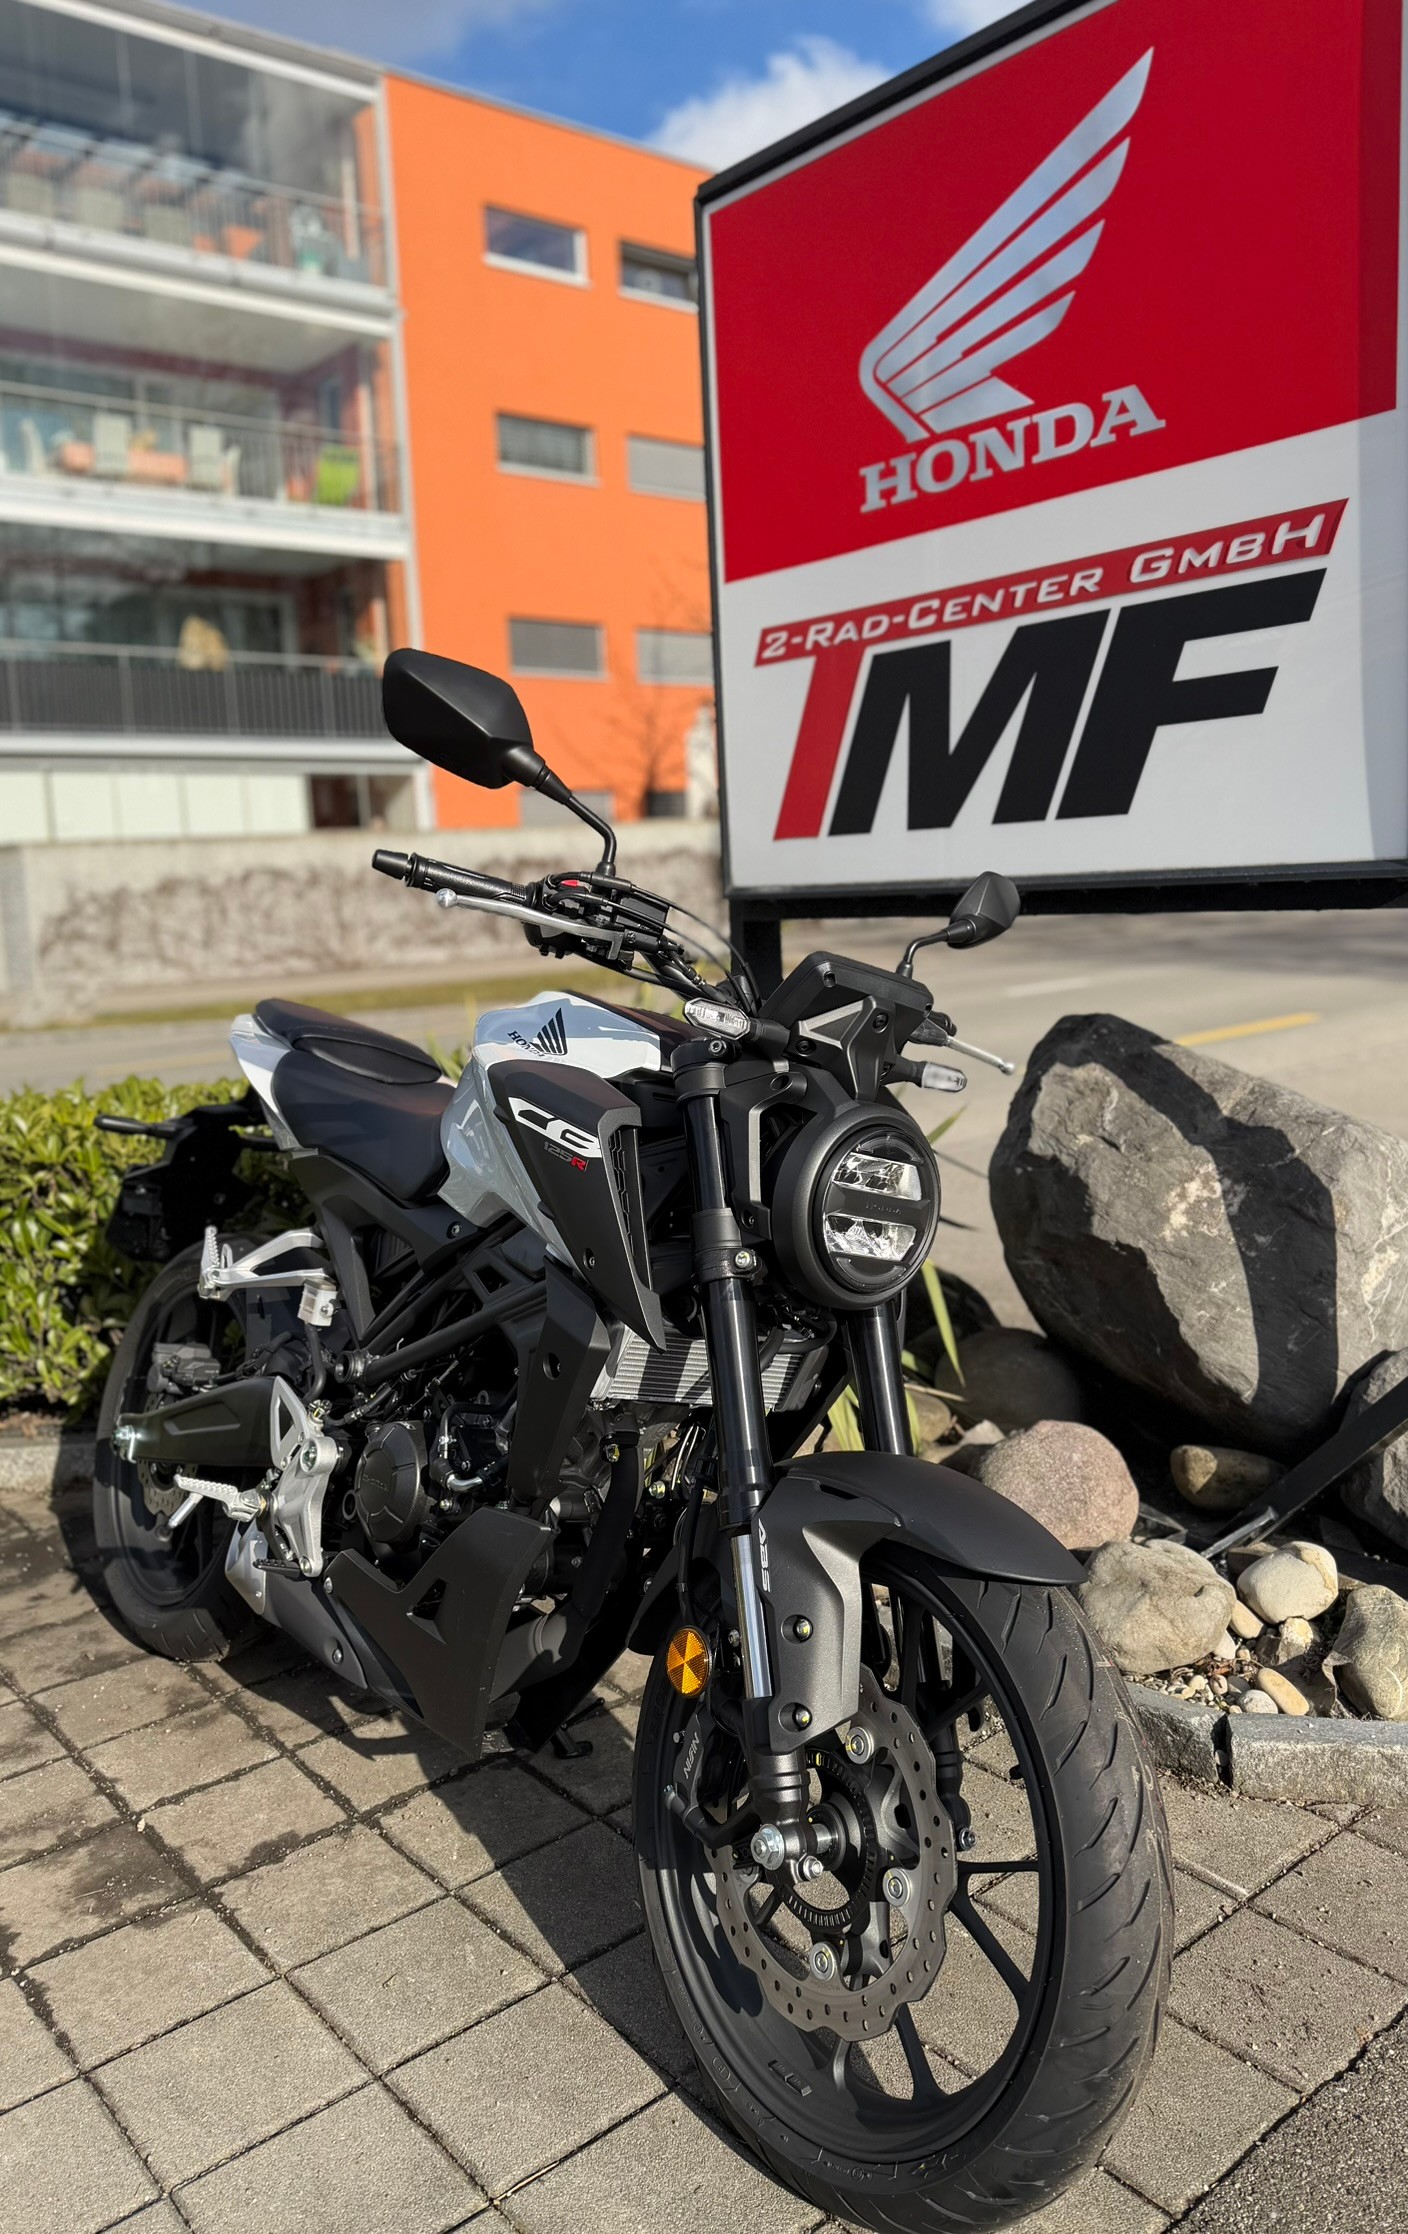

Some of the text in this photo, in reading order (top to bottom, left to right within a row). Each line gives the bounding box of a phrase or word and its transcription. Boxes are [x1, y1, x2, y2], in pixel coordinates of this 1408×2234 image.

[859, 384, 1166, 514] HONDA
[756, 567, 1328, 841] TMF
[508, 1097, 602, 1159] CB
[544, 1141, 588, 1172] 125R
[758, 1518, 771, 1593] ABS
